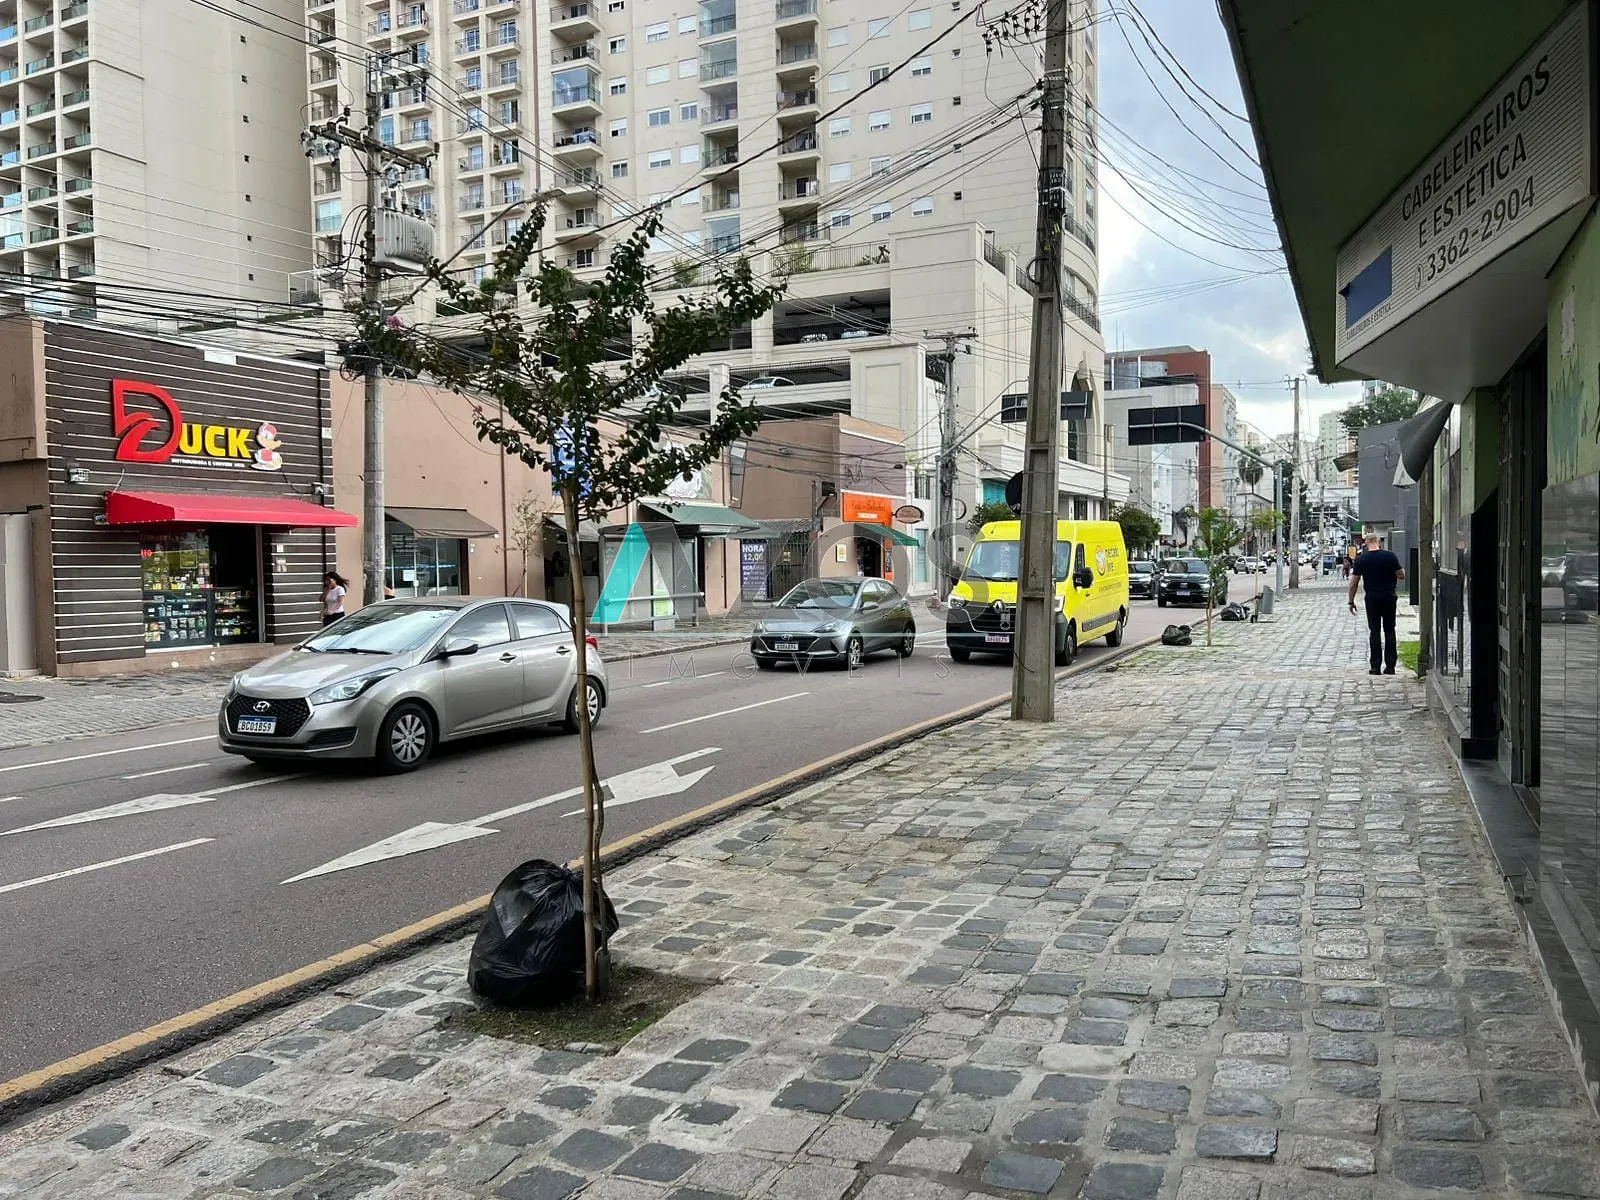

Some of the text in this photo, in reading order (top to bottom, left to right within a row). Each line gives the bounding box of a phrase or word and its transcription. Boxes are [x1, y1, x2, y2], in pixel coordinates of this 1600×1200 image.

[1402, 55, 1550, 222] CABELEIREIROS
[1419, 132, 1527, 249] E ESTÉTICA
[1427, 175, 1535, 283] 3362-2904
[742, 544, 765, 553] HORA
